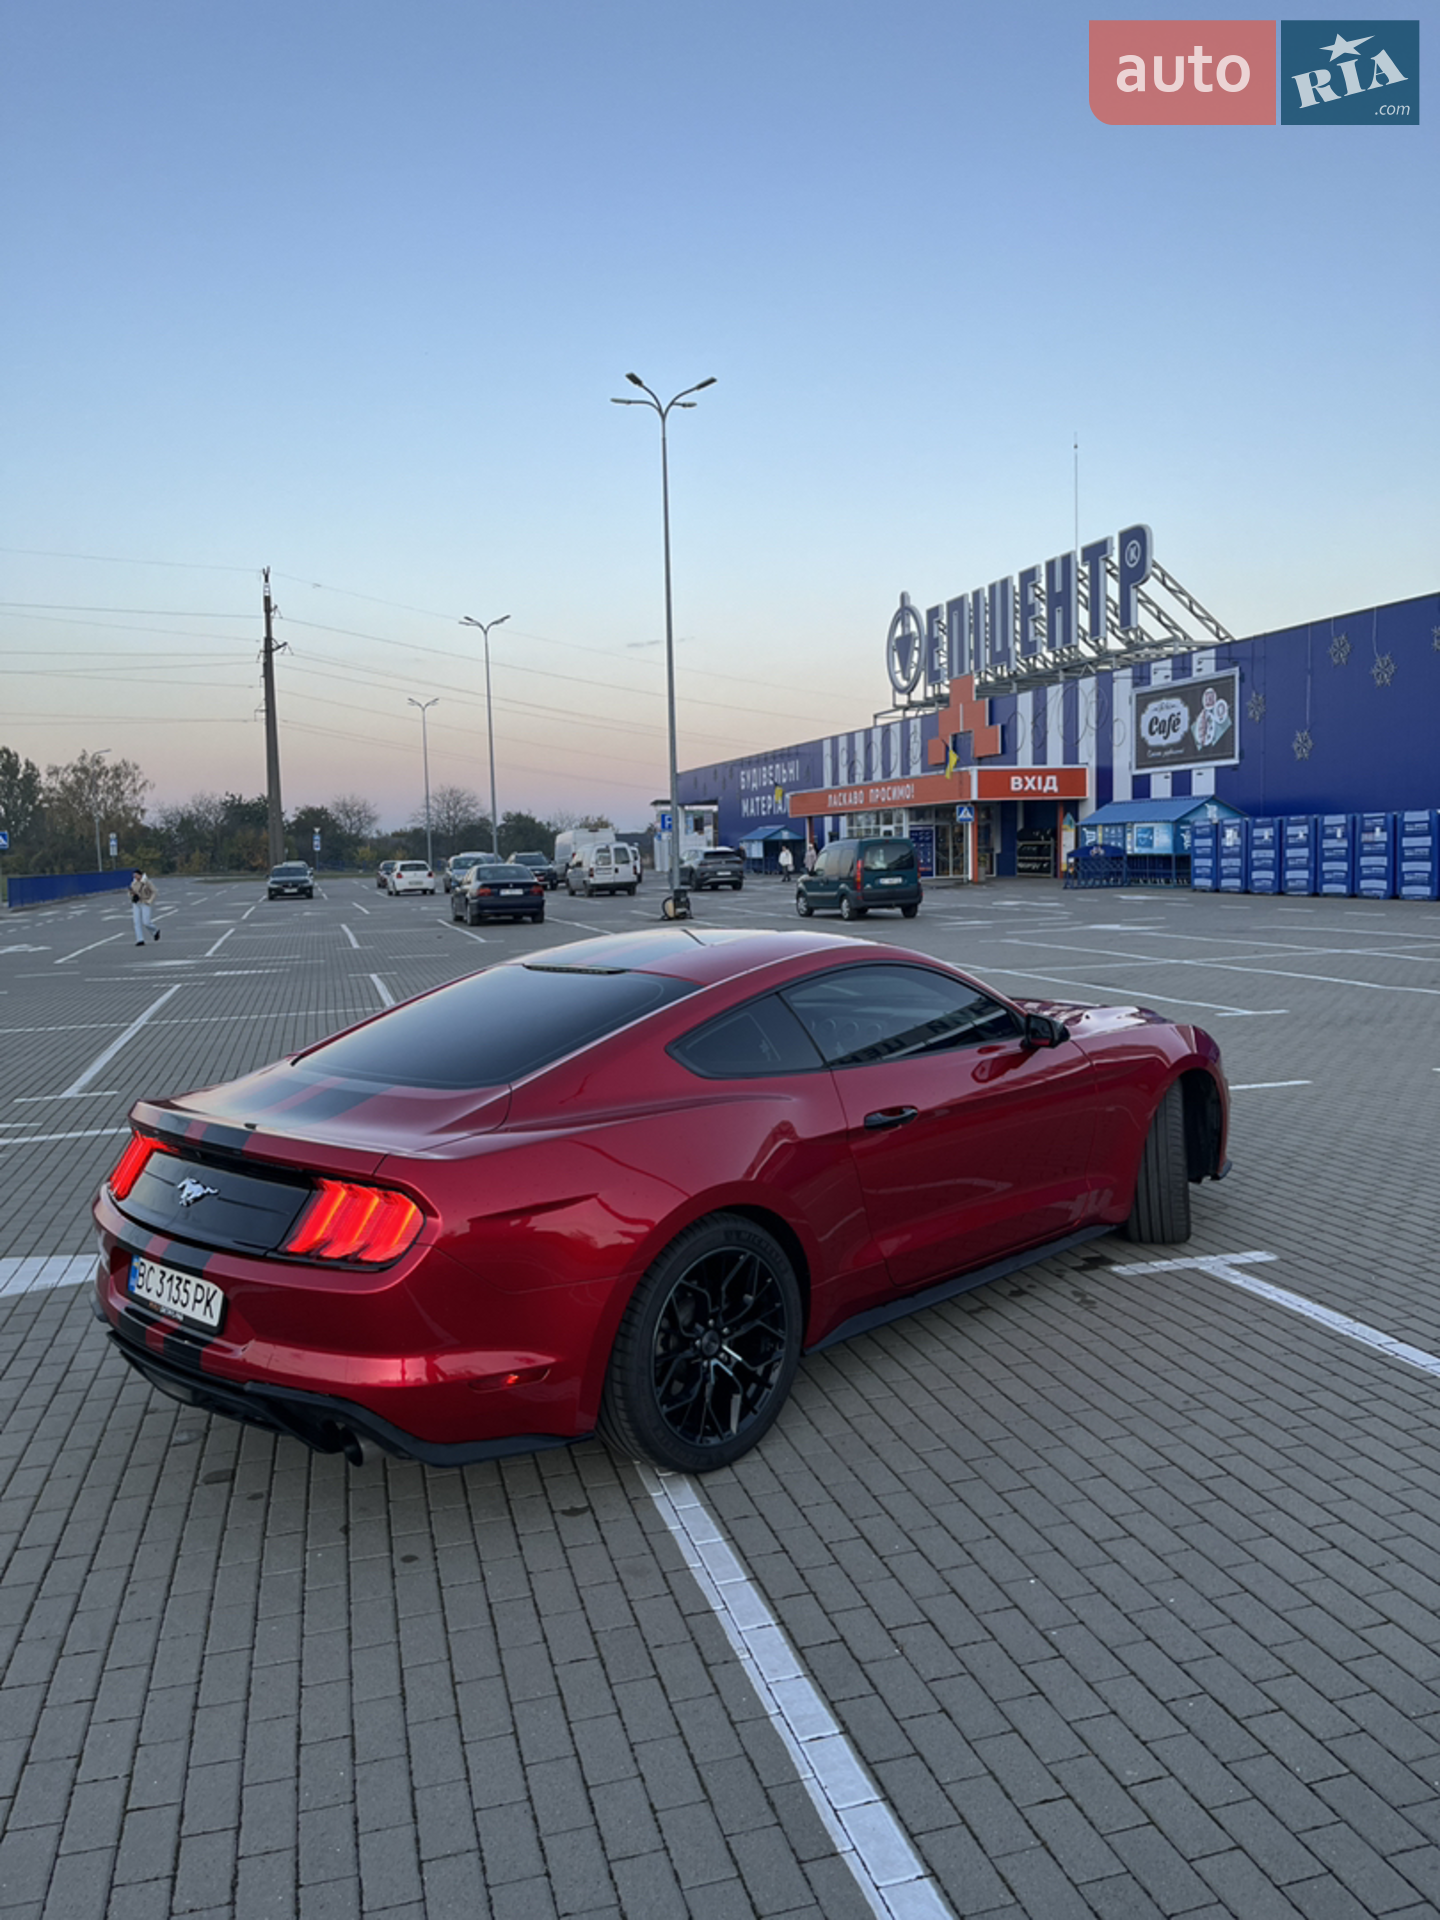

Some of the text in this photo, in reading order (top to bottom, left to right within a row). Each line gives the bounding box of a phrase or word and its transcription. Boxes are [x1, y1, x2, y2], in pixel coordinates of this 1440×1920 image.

[926, 524, 1152, 686] ЕПІЦЕНТР
[1148, 710, 1182, 740] Café
[740, 759, 799, 791] БУДІВЕЛЬНІ
[1010, 775, 1060, 793] ВХІД
[828, 783, 915, 807] ЛАСКАВО ПРОСИМО!
[136, 1262, 155, 1293] BC
[156, 1270, 191, 1308] 3135
[192, 1283, 217, 1319] PK
